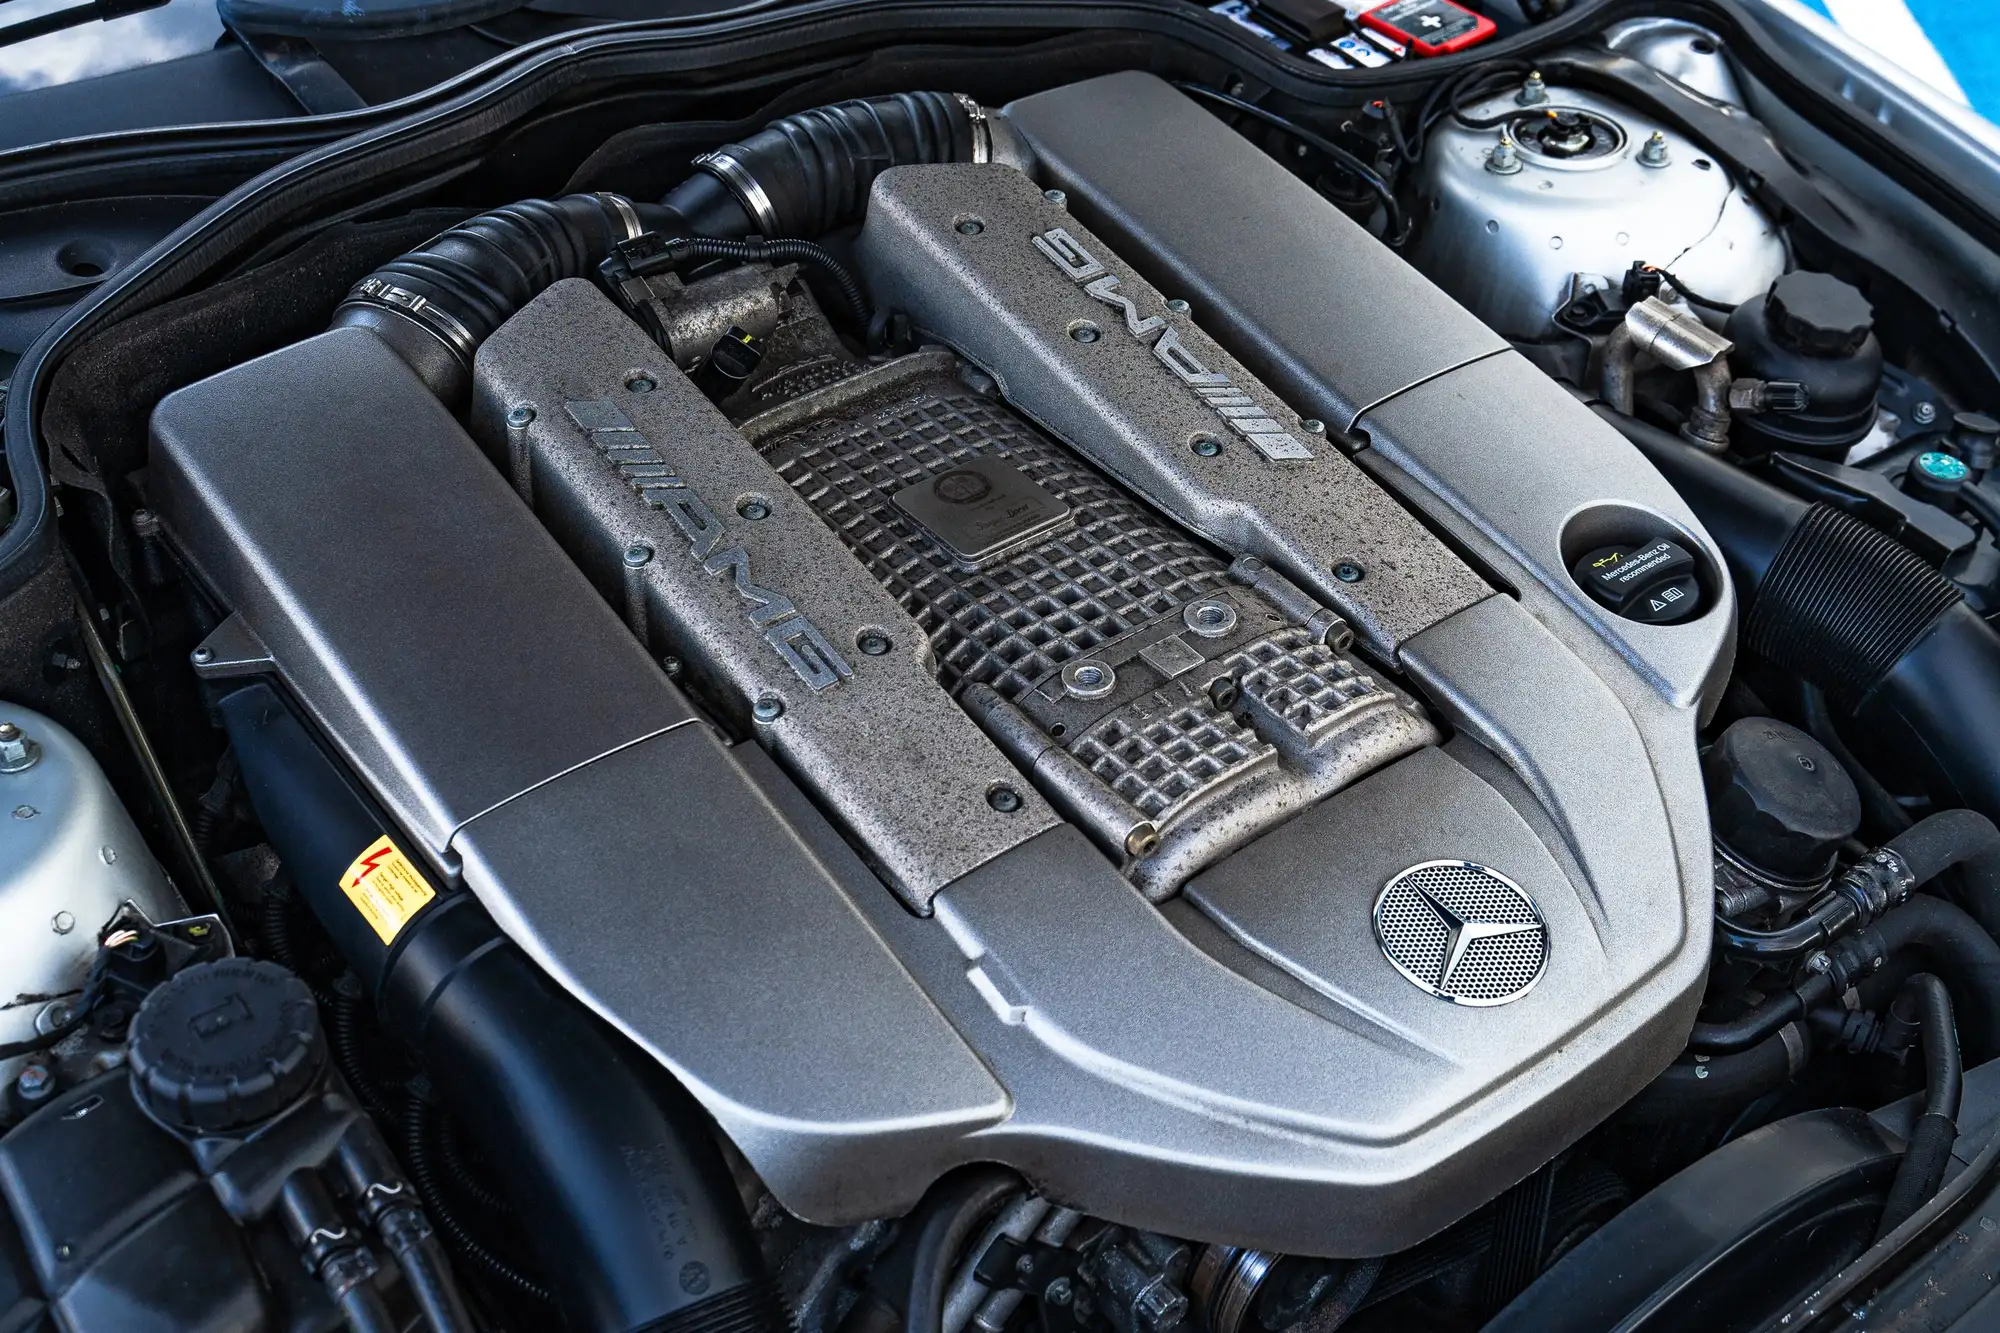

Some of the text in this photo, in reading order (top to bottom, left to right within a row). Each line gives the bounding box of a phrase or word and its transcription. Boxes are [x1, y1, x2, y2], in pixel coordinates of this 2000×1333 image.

[1601, 542, 1670, 580] Mercedes-Benz Oil
[1619, 552, 1671, 583] recommended
[642, 487, 853, 691] AMG
